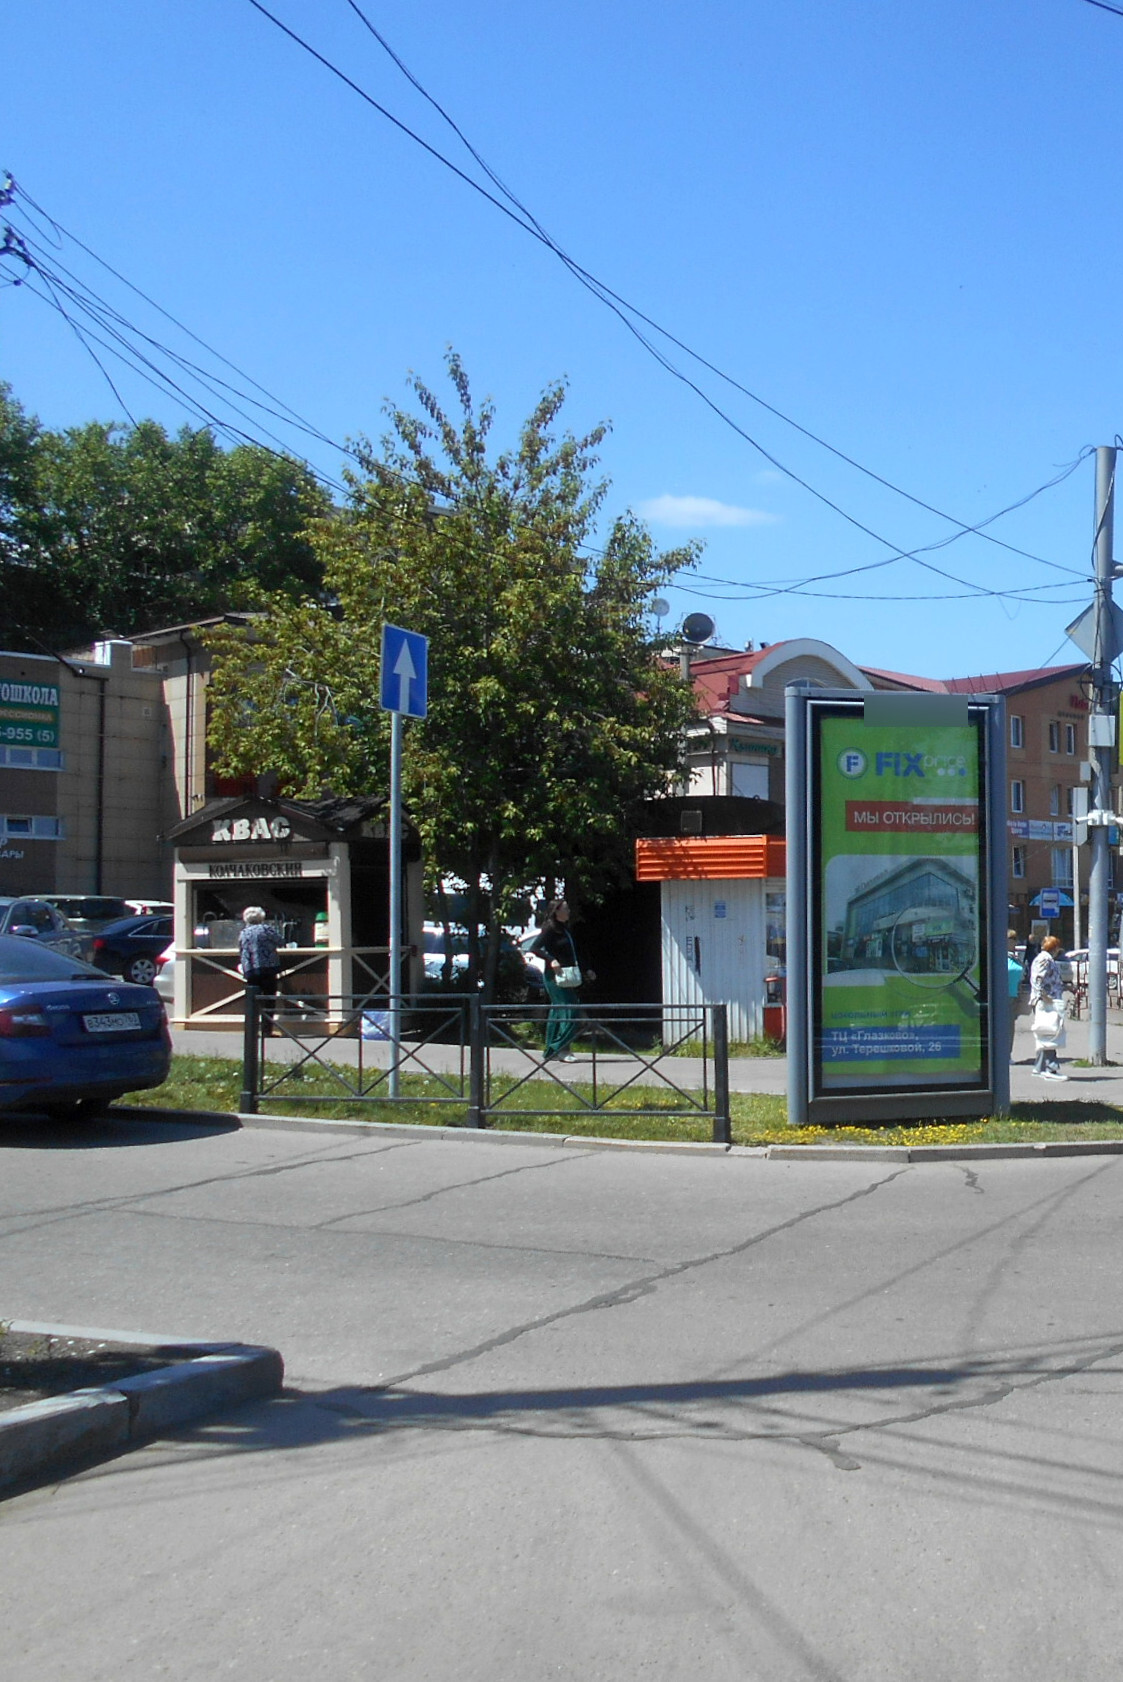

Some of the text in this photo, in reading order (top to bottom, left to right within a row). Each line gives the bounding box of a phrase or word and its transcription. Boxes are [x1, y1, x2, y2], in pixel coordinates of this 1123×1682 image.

[0, 683, 58, 706] ОШКОЛА
[0, 727, 55, 742] -955 (5)
[854, 811, 975, 825] МЫ ОТКРЫЛИСЬ!
[212, 816, 291, 841] КВАС
[832, 1031, 848, 1042] ТЦ
[831, 1042, 942, 1057] ул. Терешковой, 26
